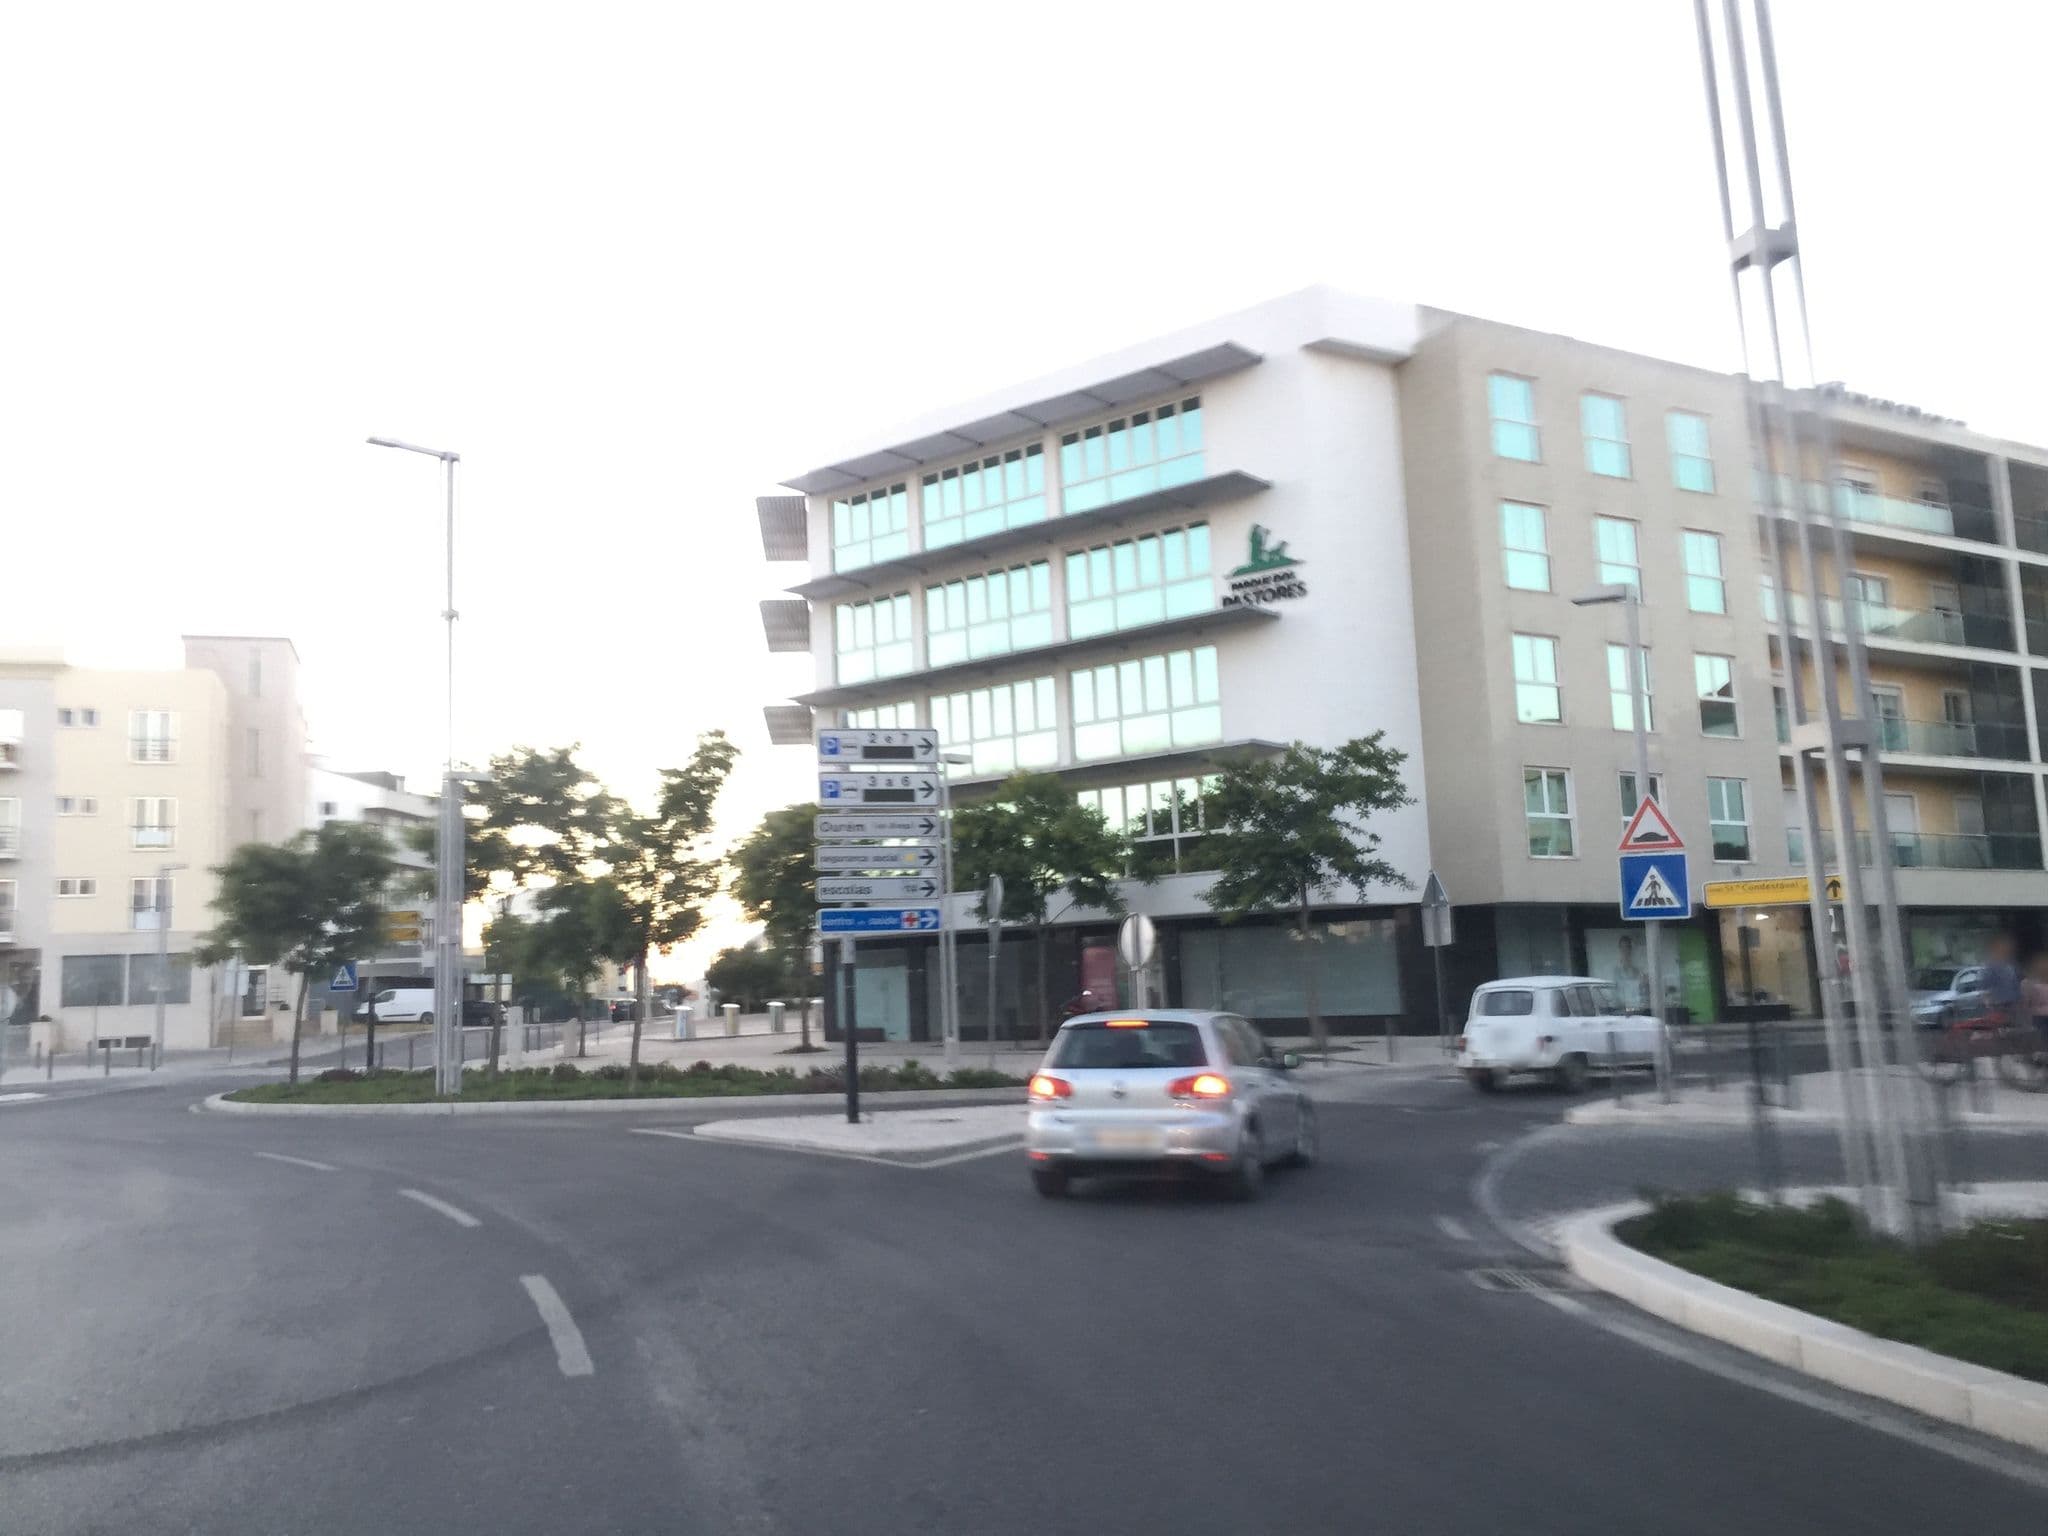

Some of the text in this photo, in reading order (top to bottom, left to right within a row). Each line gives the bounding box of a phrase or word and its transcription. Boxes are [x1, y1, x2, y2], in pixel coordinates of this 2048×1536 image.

[1222, 582, 1308, 607] PASTORES
[868, 733, 877, 744] 2
[868, 776, 878, 787] 3
